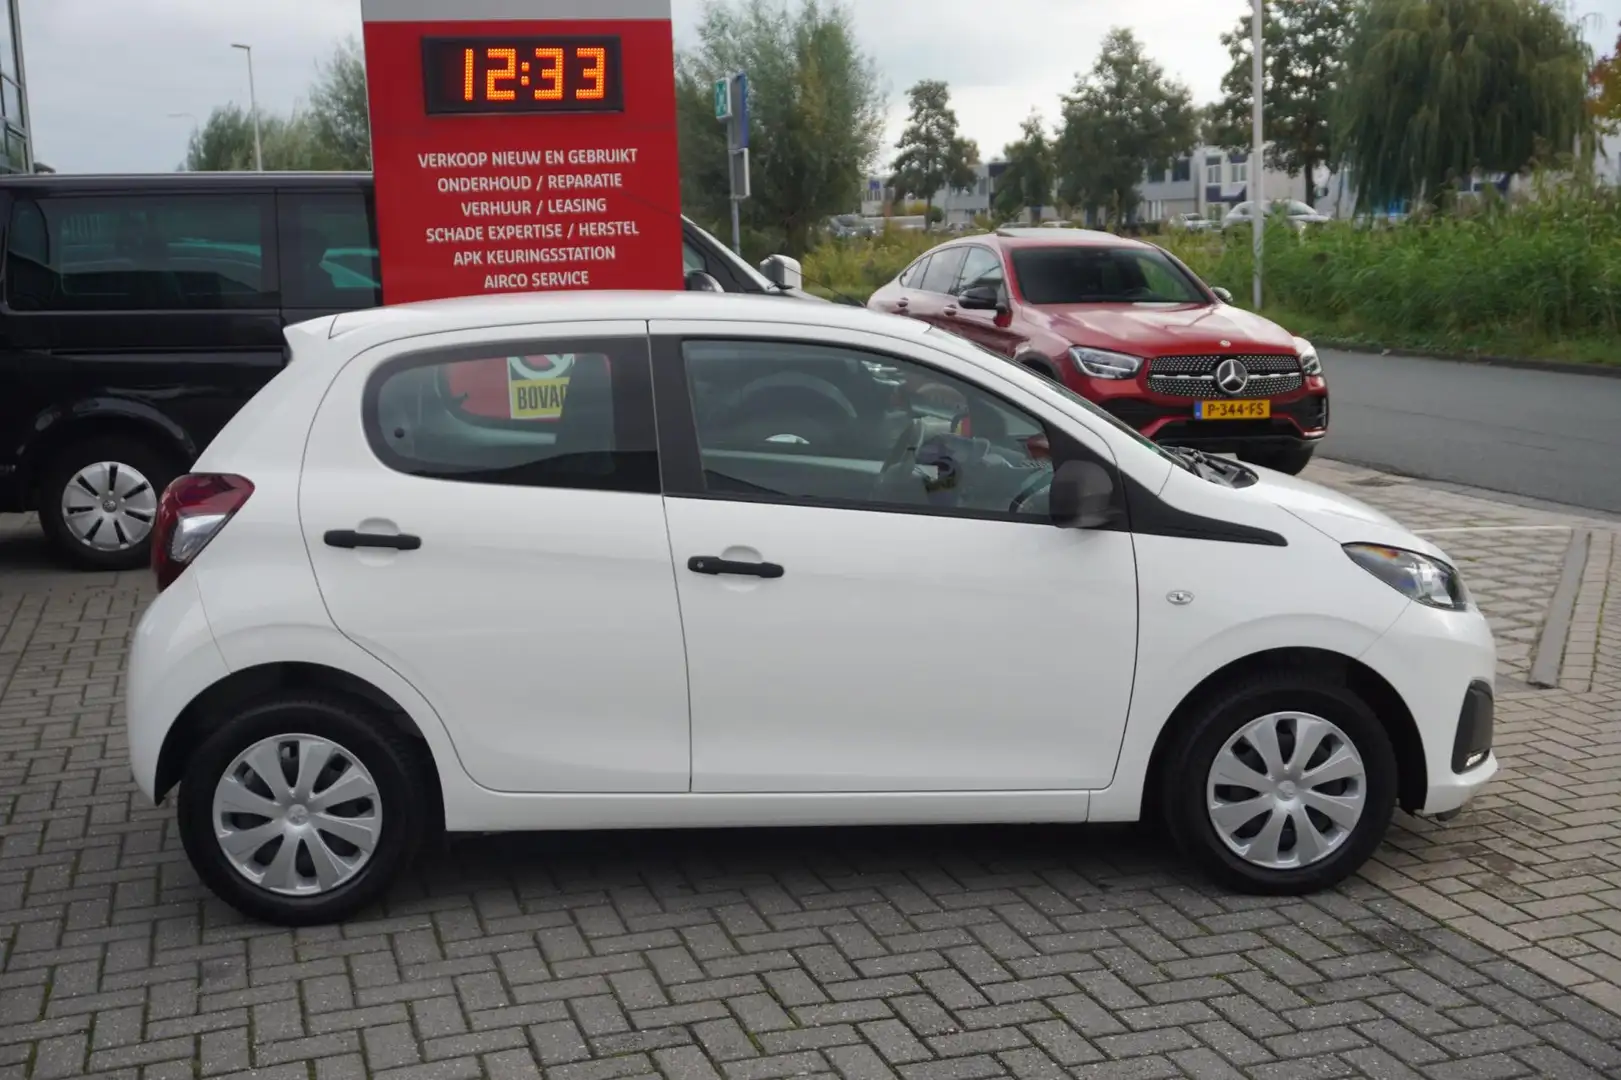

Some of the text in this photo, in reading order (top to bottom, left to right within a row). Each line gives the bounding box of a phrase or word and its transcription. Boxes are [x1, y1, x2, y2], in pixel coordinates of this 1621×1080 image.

[463, 47, 605, 101] 12:33
[417, 147, 639, 169] VERKOOP NIEUW EN GEBRUIKT
[436, 172, 623, 193] ONDERHOUD / REPARATIE
[460, 197, 607, 217] VERHUUR / LEASING
[425, 220, 641, 244] SCHADE EXPERTISE / HERSTEL
[453, 245, 616, 267] APK KEURINGSSTATION
[483, 270, 590, 290] AIRCO SERVICE
[1207, 402, 1265, 417] P-344-FS
